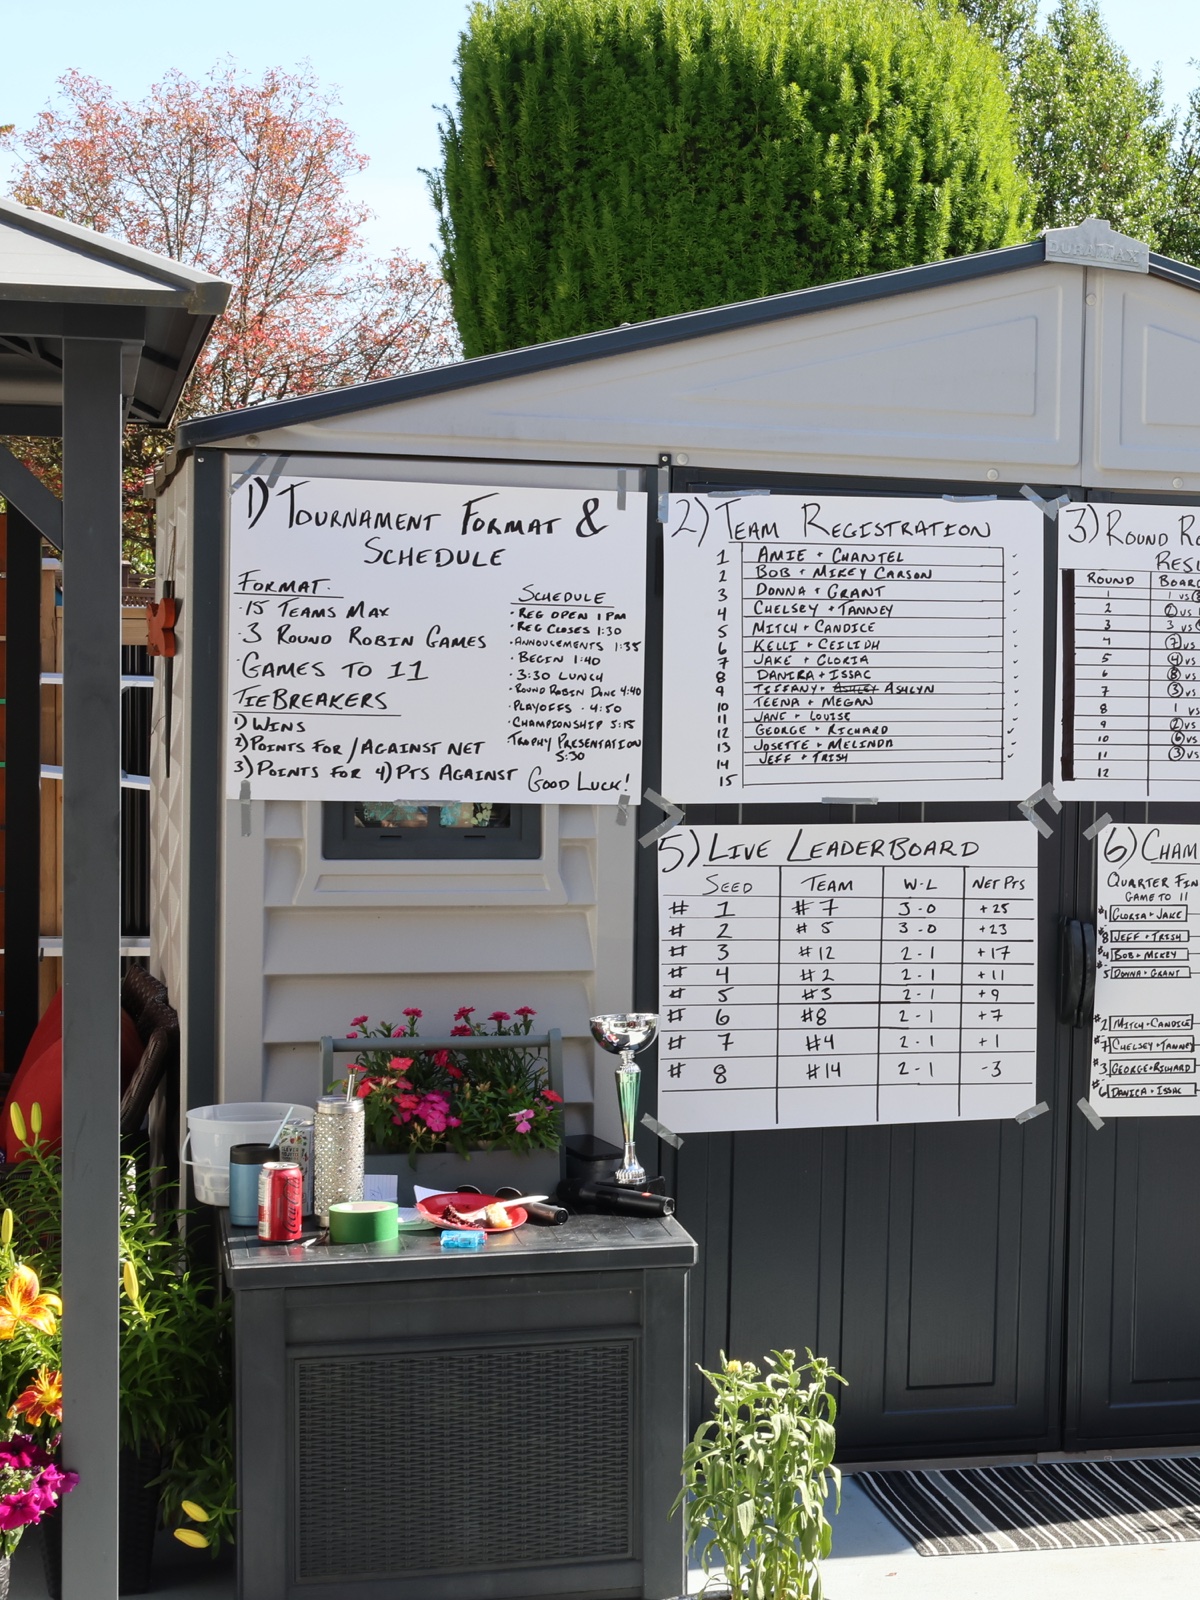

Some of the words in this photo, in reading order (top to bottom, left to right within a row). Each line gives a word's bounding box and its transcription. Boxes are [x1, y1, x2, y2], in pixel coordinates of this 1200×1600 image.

[276, 480, 442, 532] TOURNAMENT
[460, 492, 562, 536] FORMAT
[574, 497, 609, 538] &
[715, 498, 780, 541] TEAM
[802, 502, 991, 539] REGISTRATION
[1106, 509, 1169, 547] ROUND
[363, 536, 507, 568] SCHEDULE
[758, 546, 808, 563] AMIE
[832, 548, 904, 564] CHANTEL
[756, 565, 791, 578] BOB
[874, 566, 932, 581] CARSON
[1088, 575, 1134, 585] ROUND
[518, 583, 607, 604] SCHEDULE
[755, 583, 806, 597] DONNA
[828, 585, 886, 599] GRANT
[245, 601, 270, 616] 15
[277, 599, 337, 619] TEAMS
[345, 601, 390, 619] MAX
[518, 608, 545, 620] REG
[551, 610, 588, 621] OPEN
[597, 612, 602, 621] 1
[605, 612, 626, 621] PM
[753, 601, 819, 618] CHELSEY
[516, 622, 543, 633] REG
[547, 625, 591, 636] CLOSES
[597, 625, 622, 636] 1:30
[752, 621, 798, 635] MITCH
[815, 619, 875, 634] CANDICE
[242, 623, 263, 644] 3
[276, 623, 332, 646] ROUND
[349, 627, 414, 649] ROBIN
[426, 625, 487, 649] GAMES
[614, 640, 642, 652] 1:35
[241, 651, 326, 679] GAMES
[341, 662, 372, 678] TO
[387, 660, 429, 681] 11
[518, 653, 564, 665] BEGIN
[574, 654, 601, 666] 1:40
[753, 654, 792, 666] JAKE
[516, 669, 551, 681] 3:30
[559, 671, 604, 682] LUNCH
[515, 684, 546, 695] ROUND
[549, 684, 585, 697] ROBIN
[620, 685, 641, 697] 4:40
[884, 682, 934, 694] ASHLYN
[514, 702, 572, 714] PLAYOFFS
[589, 703, 622, 714] 4:50
[754, 696, 800, 707] TEENA
[821, 696, 874, 708] MEGAN
[512, 717, 603, 729] CHAMPIONSHIP
[610, 718, 636, 730] 5:15
[754, 711, 786, 722] JANE
[809, 711, 851, 721] LOUISE
[252, 717, 306, 733] WINS
[755, 724, 806, 736] GEORGE
[828, 724, 888, 736] RICHARD
[250, 737, 305, 755] POINTS
[311, 739, 343, 755] FOR
[448, 741, 485, 756] NET
[557, 735, 641, 750] PRESENTATION
[754, 739, 809, 750] JOSETTE
[828, 738, 893, 749] MELINDA
[556, 750, 585, 762] 5:30
[759, 752, 792, 765] JEFF
[812, 751, 849, 763] TRISH
[256, 761, 319, 779] POINTS
[331, 764, 361, 779] FOR
[439, 764, 518, 782] AGAINST
[527, 766, 569, 792] GOOD
[578, 769, 630, 792] LUCK!
[708, 832, 772, 862] LIVE
[786, 828, 980, 862] LEADERBOARD
[702, 874, 754, 896] SEED
[801, 876, 853, 893] TEAM
[972, 876, 1001, 890] NET
[1107, 871, 1168, 890] QUARTER
